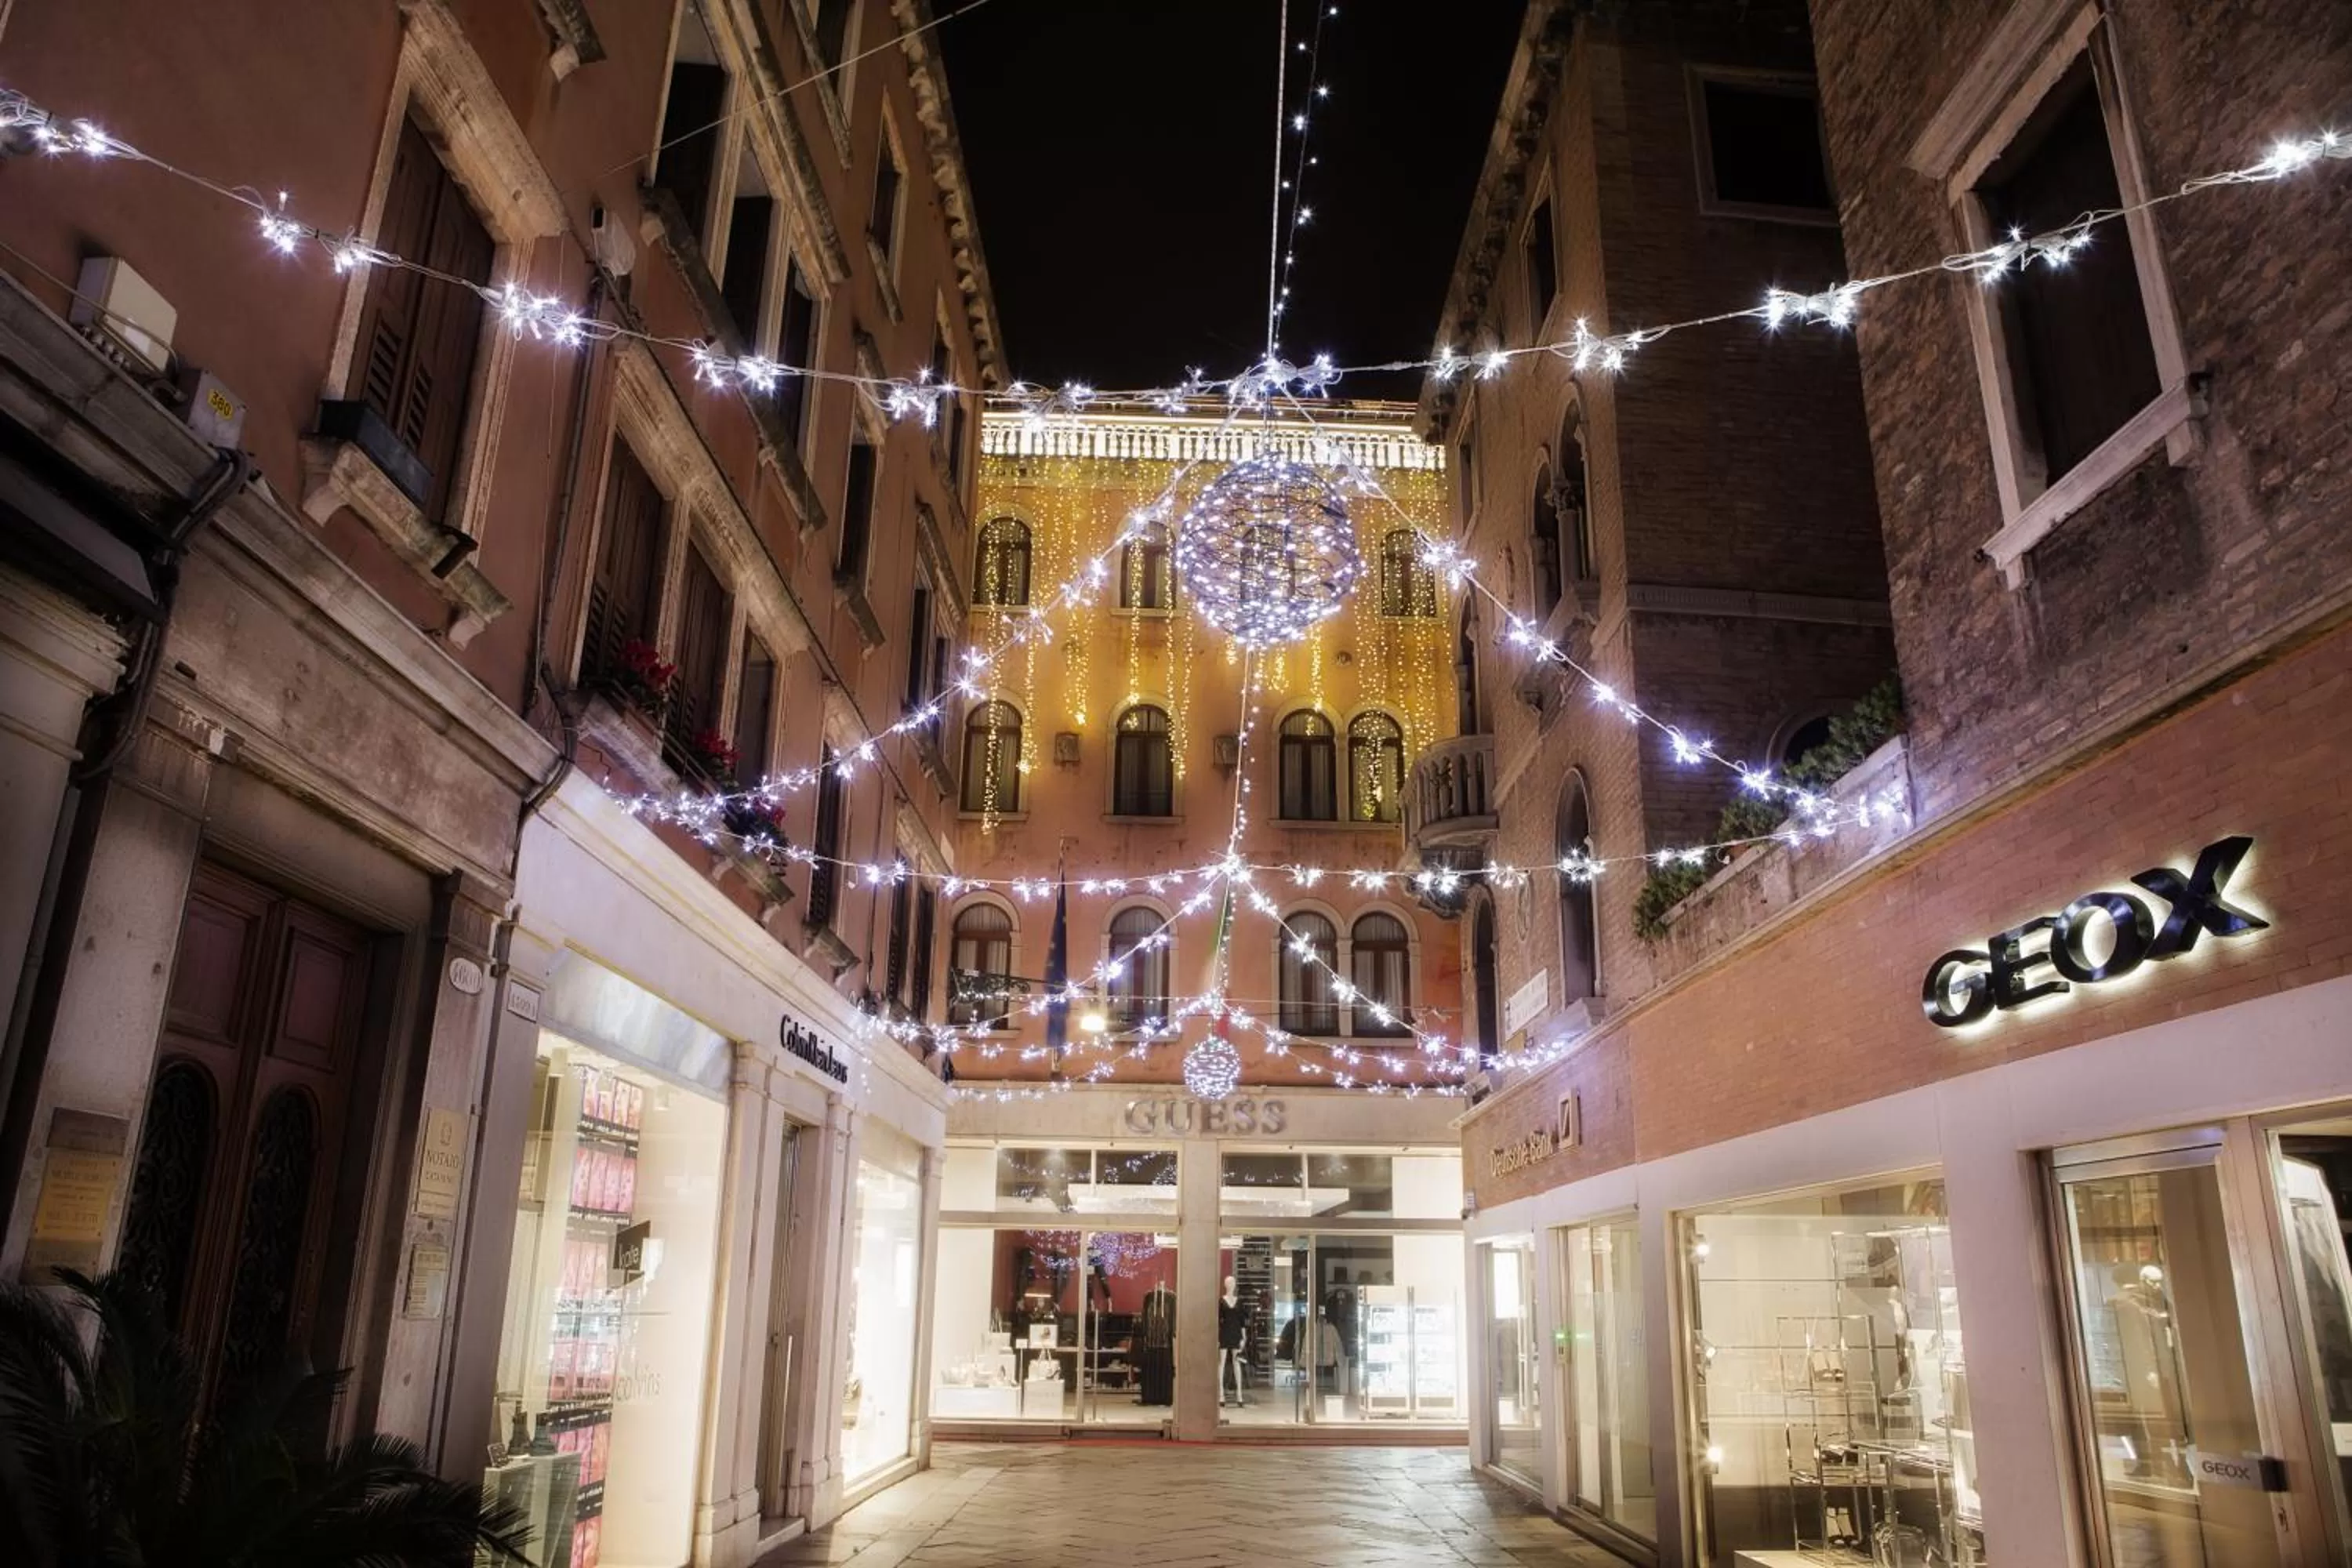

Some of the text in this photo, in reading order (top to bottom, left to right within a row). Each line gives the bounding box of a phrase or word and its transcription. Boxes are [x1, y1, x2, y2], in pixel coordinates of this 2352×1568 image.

[1922, 836, 2270, 1028] GEOX
[1124, 1099, 1287, 1134] GUESS
[2201, 1461, 2251, 1480] GEOX
